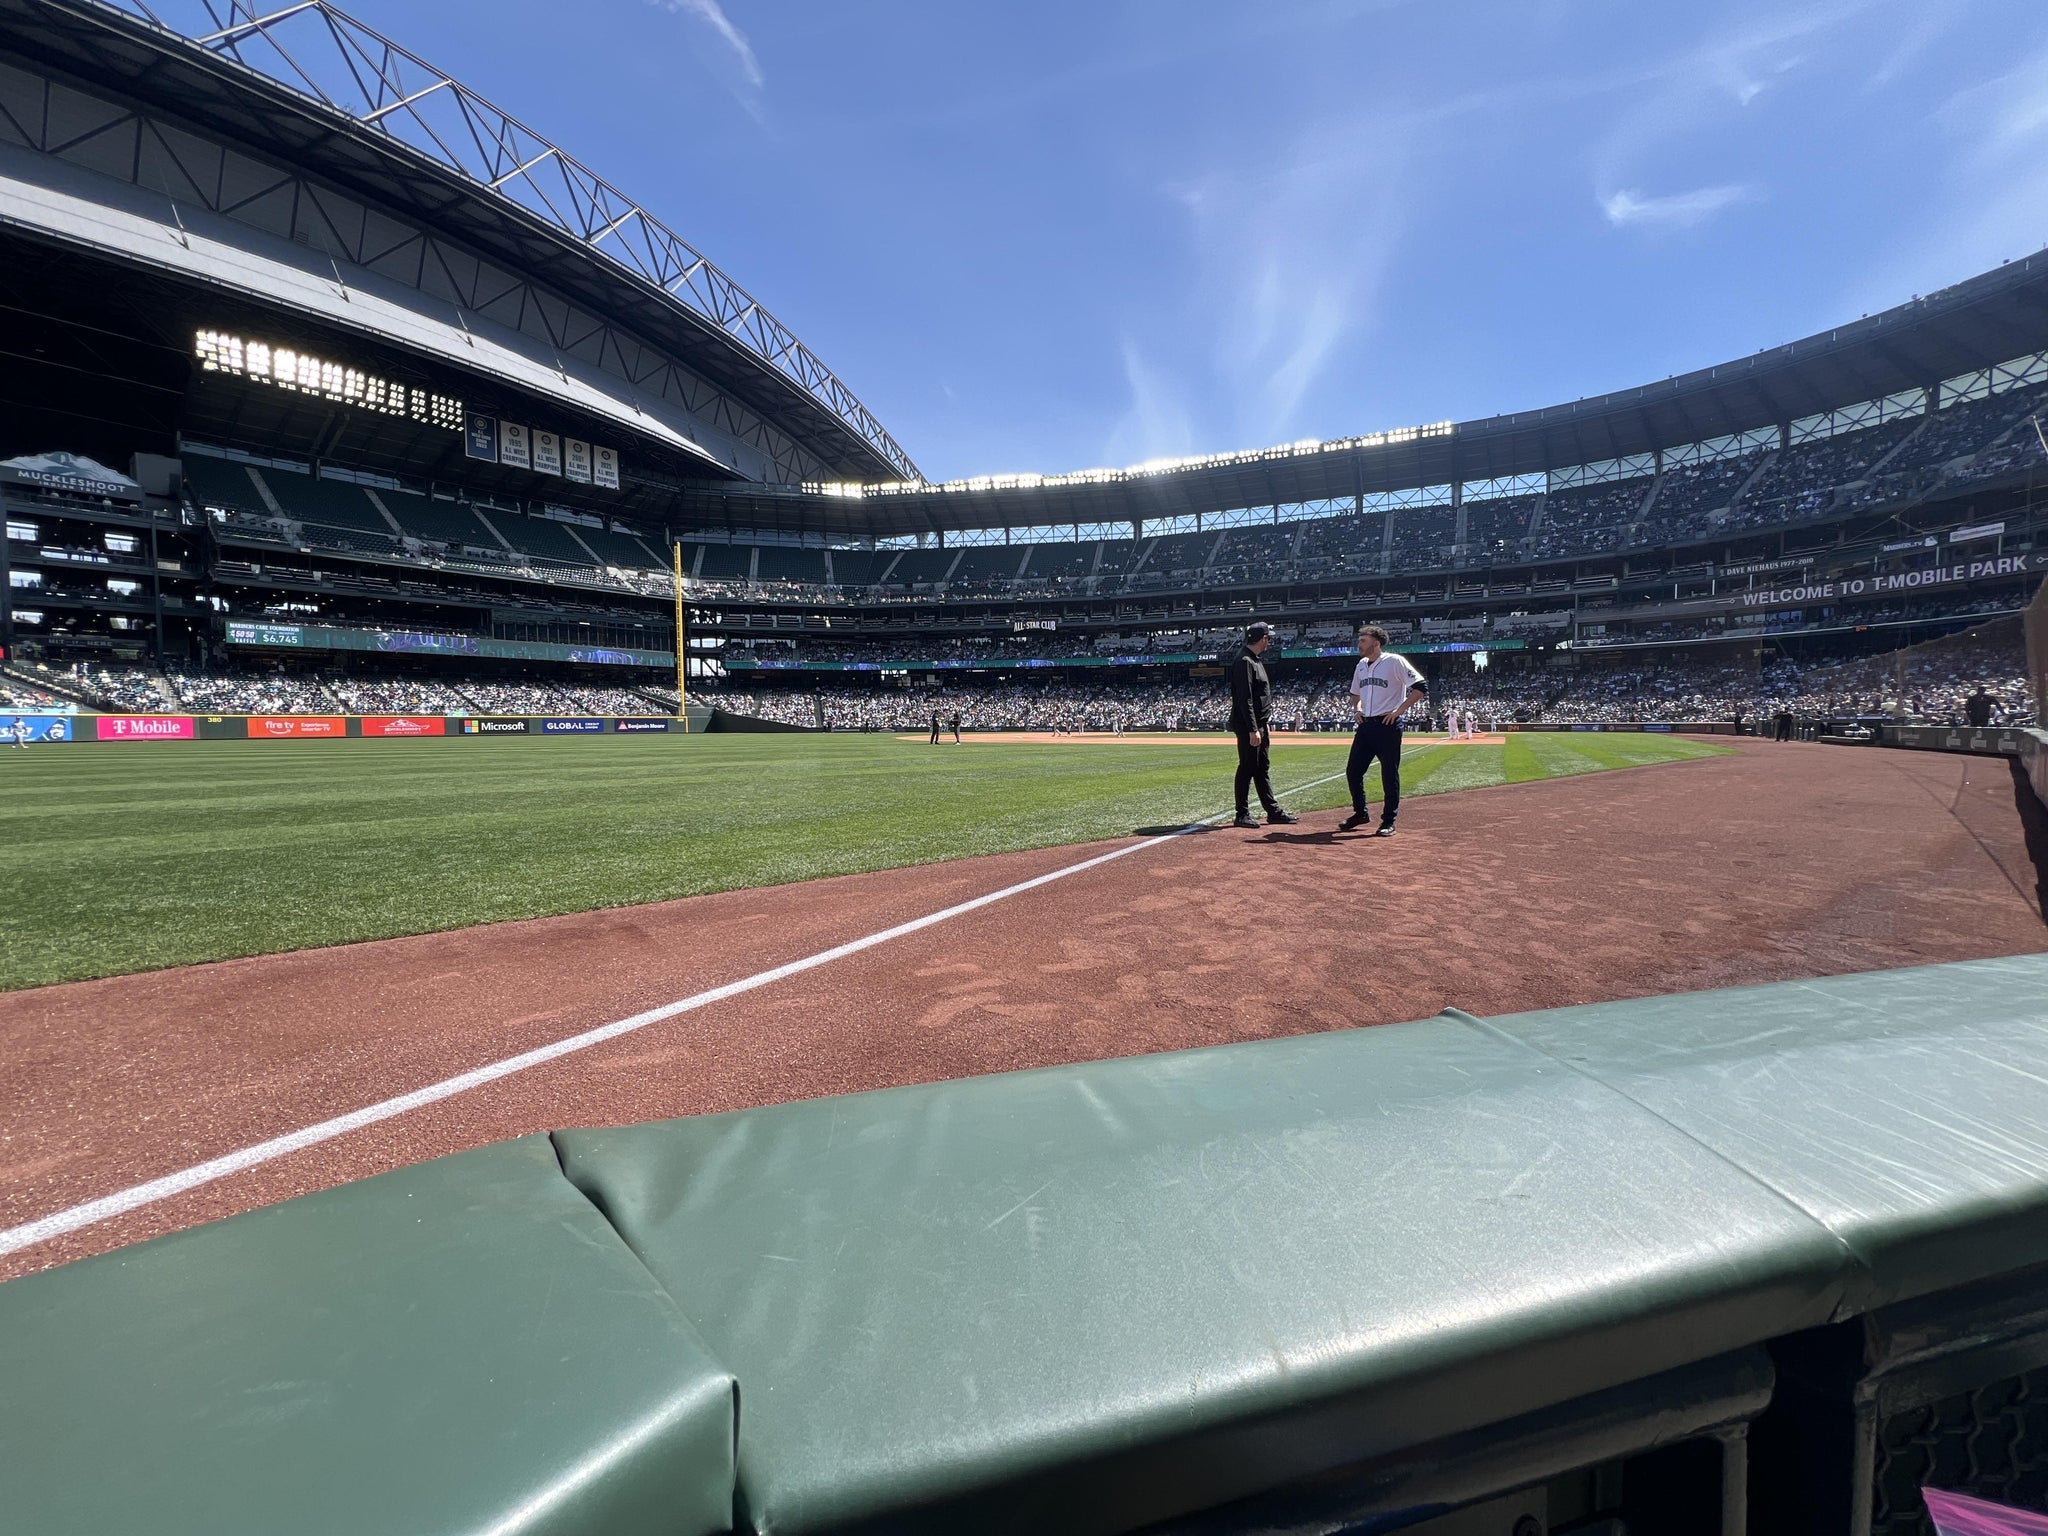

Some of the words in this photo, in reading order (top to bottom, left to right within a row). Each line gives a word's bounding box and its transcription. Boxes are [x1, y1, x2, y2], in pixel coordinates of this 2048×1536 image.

[503, 454, 529, 465] CHAMPIONS
[535, 461, 560, 472] CHAMPIONS
[567, 469, 590, 479] CHAMPIONS
[18, 470, 126, 492] MUCKLESHOOT
[39, 481, 74, 489] INDIAN
[596, 476, 618, 485] CHAMPIONS
[1727, 566, 1745, 575] DAVE
[1747, 562, 1779, 573] NIEHAUS
[1780, 558, 1814, 568] 1977-2010
[1744, 584, 1834, 605] WELCOME
[1840, 580, 1864, 595] TO
[1872, 565, 1965, 590] T-MOBILE
[1970, 555, 2027, 577] PARK
[1041, 621, 1056, 631] CLUB
[130, 720, 180, 733] Mobile
[481, 722, 525, 731] Microsoft
